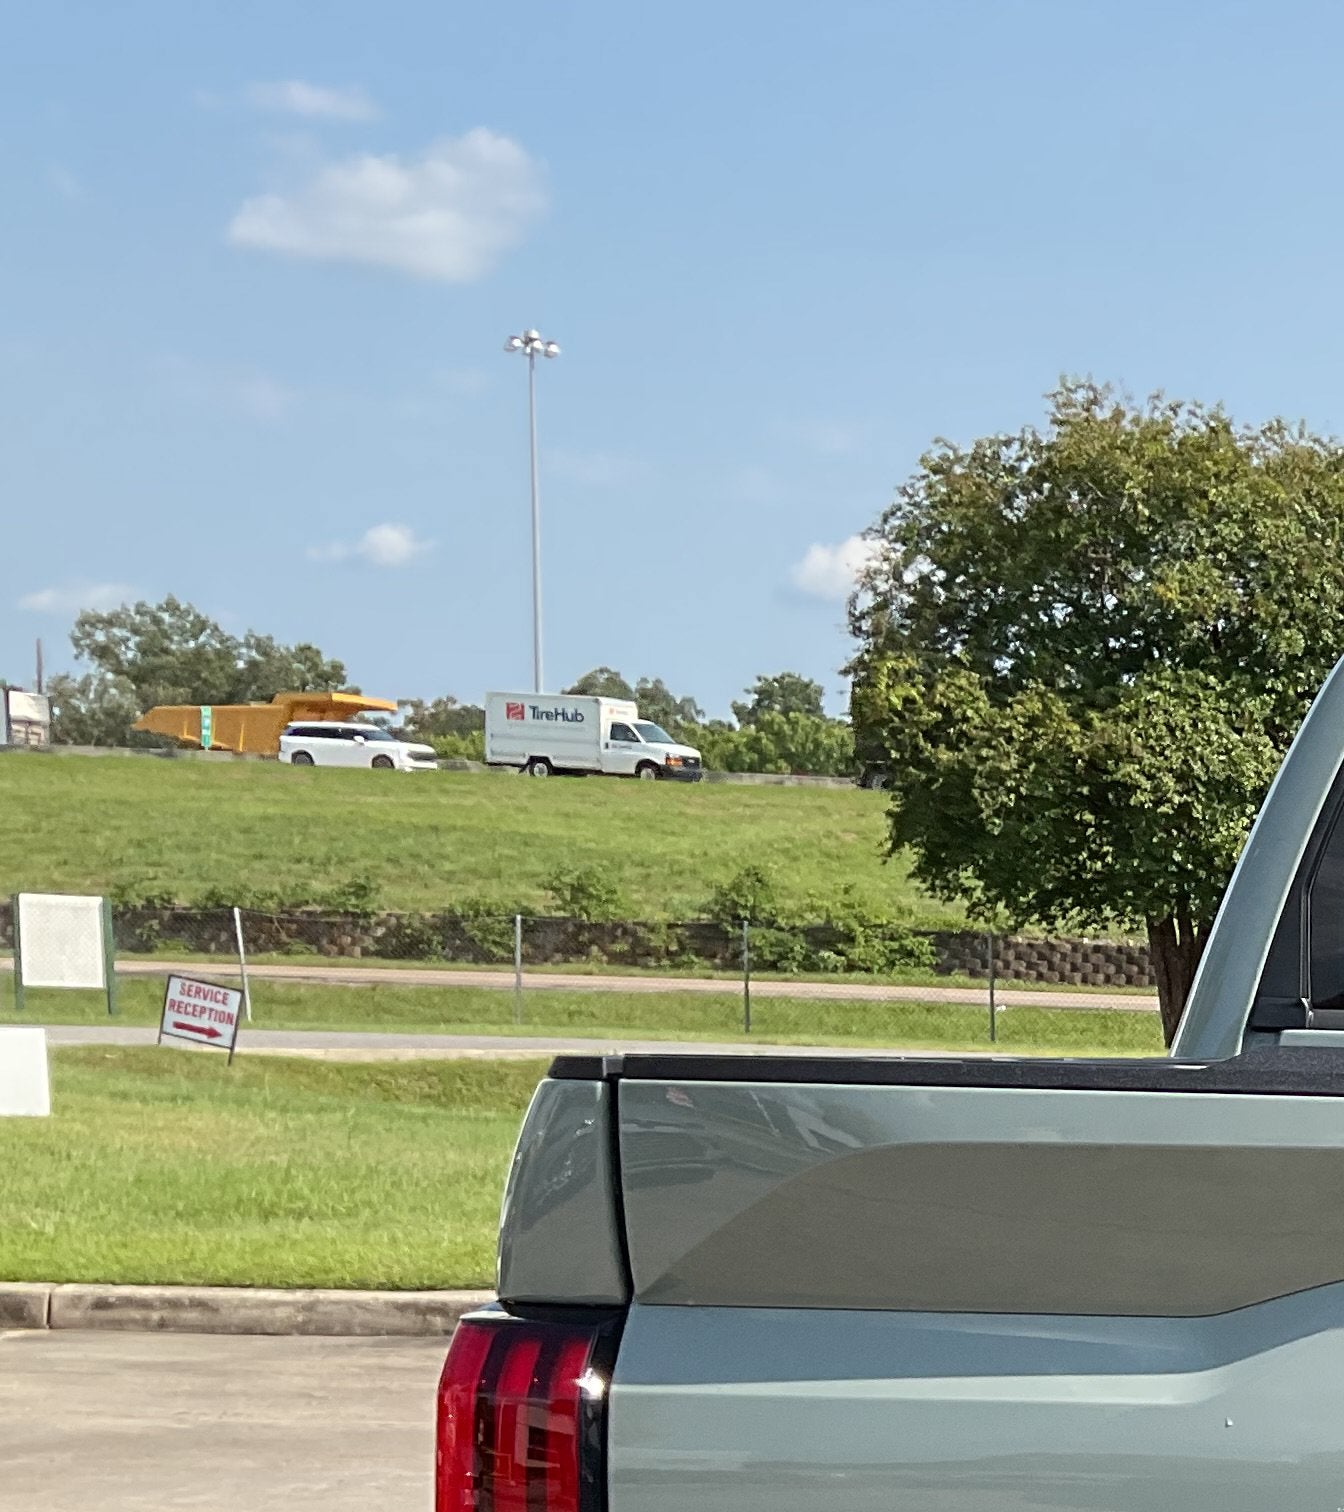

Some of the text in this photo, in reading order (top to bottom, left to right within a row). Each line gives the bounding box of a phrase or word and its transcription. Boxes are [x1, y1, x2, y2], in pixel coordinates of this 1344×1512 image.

[528, 705, 585, 723] TireHub
[179, 981, 230, 1006] SERVICE
[167, 998, 235, 1026] RECEPTION
